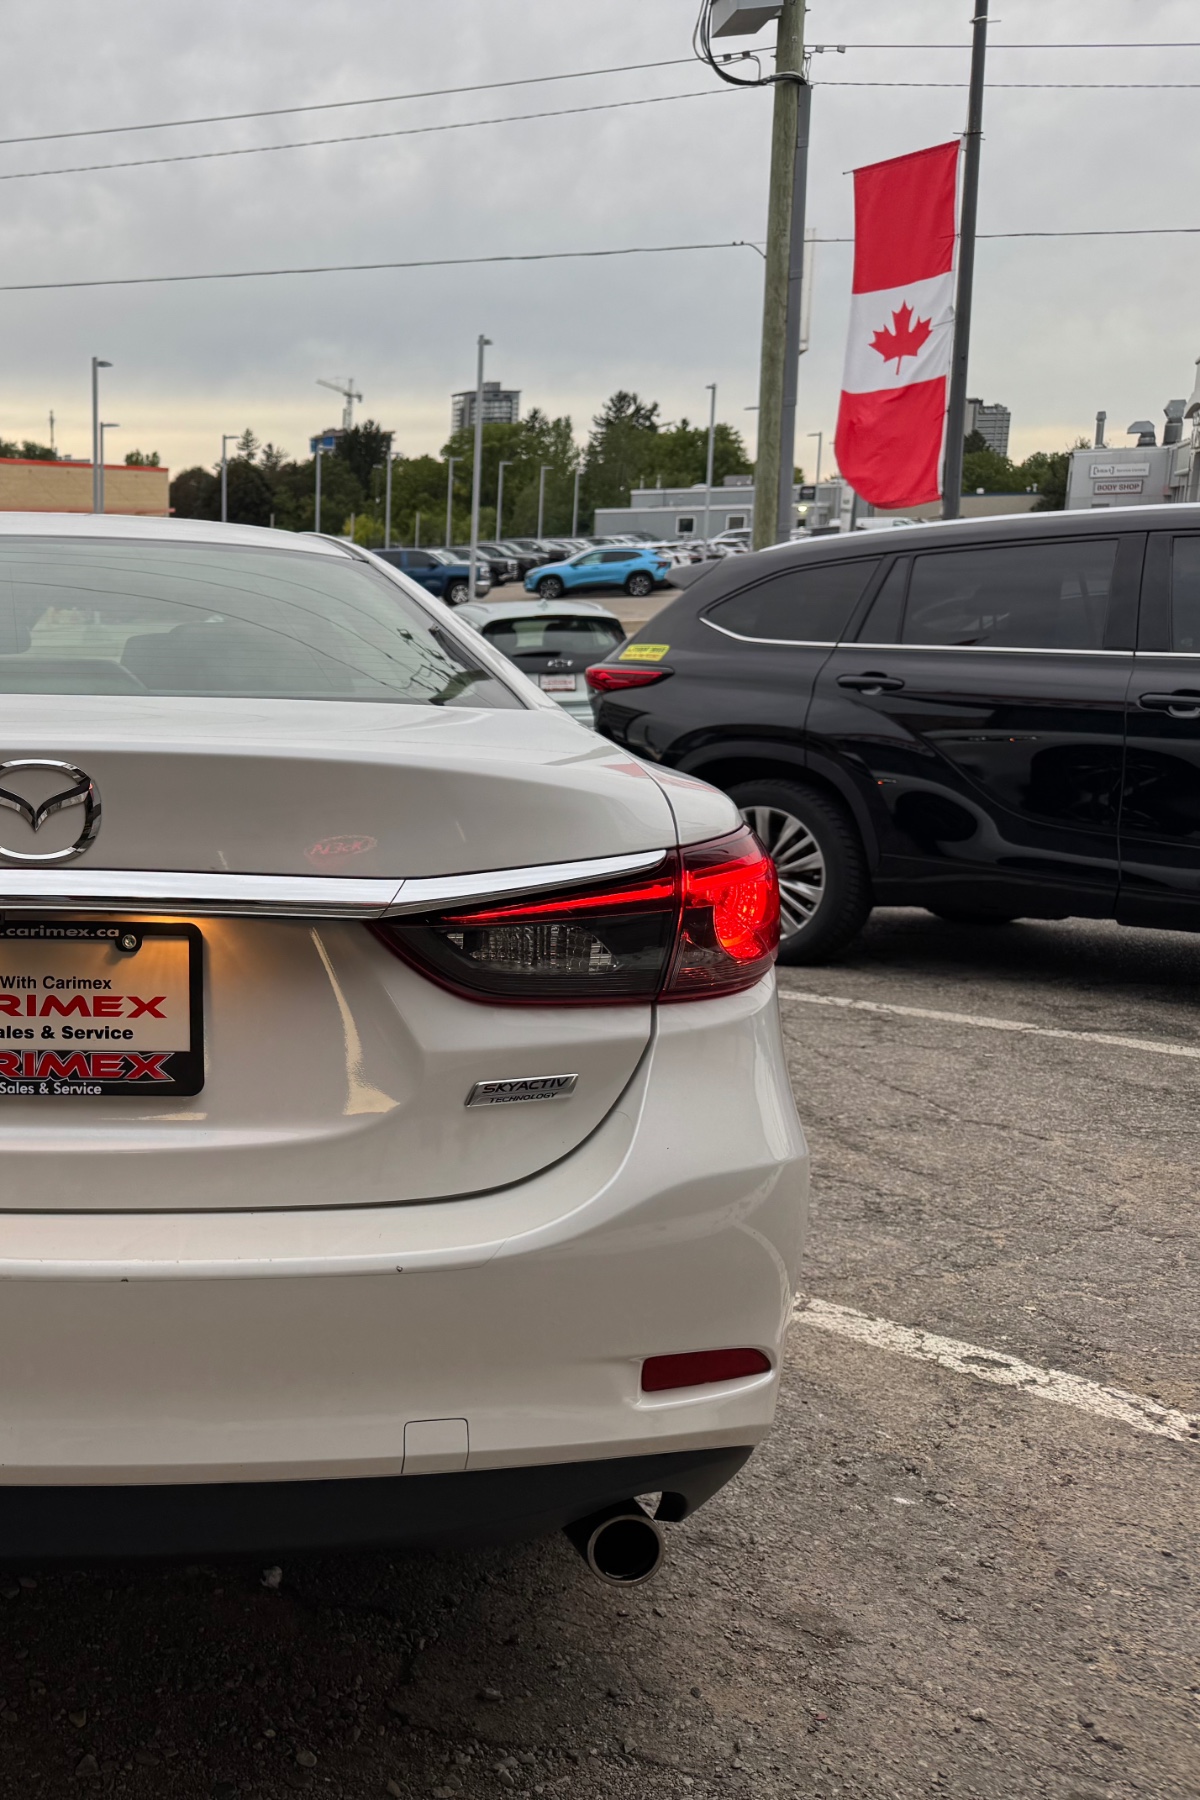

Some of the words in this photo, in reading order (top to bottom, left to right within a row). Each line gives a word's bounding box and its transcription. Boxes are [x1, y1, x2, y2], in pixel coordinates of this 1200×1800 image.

[0, 975, 37, 989] With
[42, 975, 112, 990] Carimex
[40, 1025, 56, 1039] &
[61, 1025, 134, 1040] Service
[38, 1082, 50, 1094] &
[53, 1082, 102, 1095] Service
[482, 1077, 570, 1094] SKYACTIV
[489, 1092, 559, 1103] TECHNOLOGY
